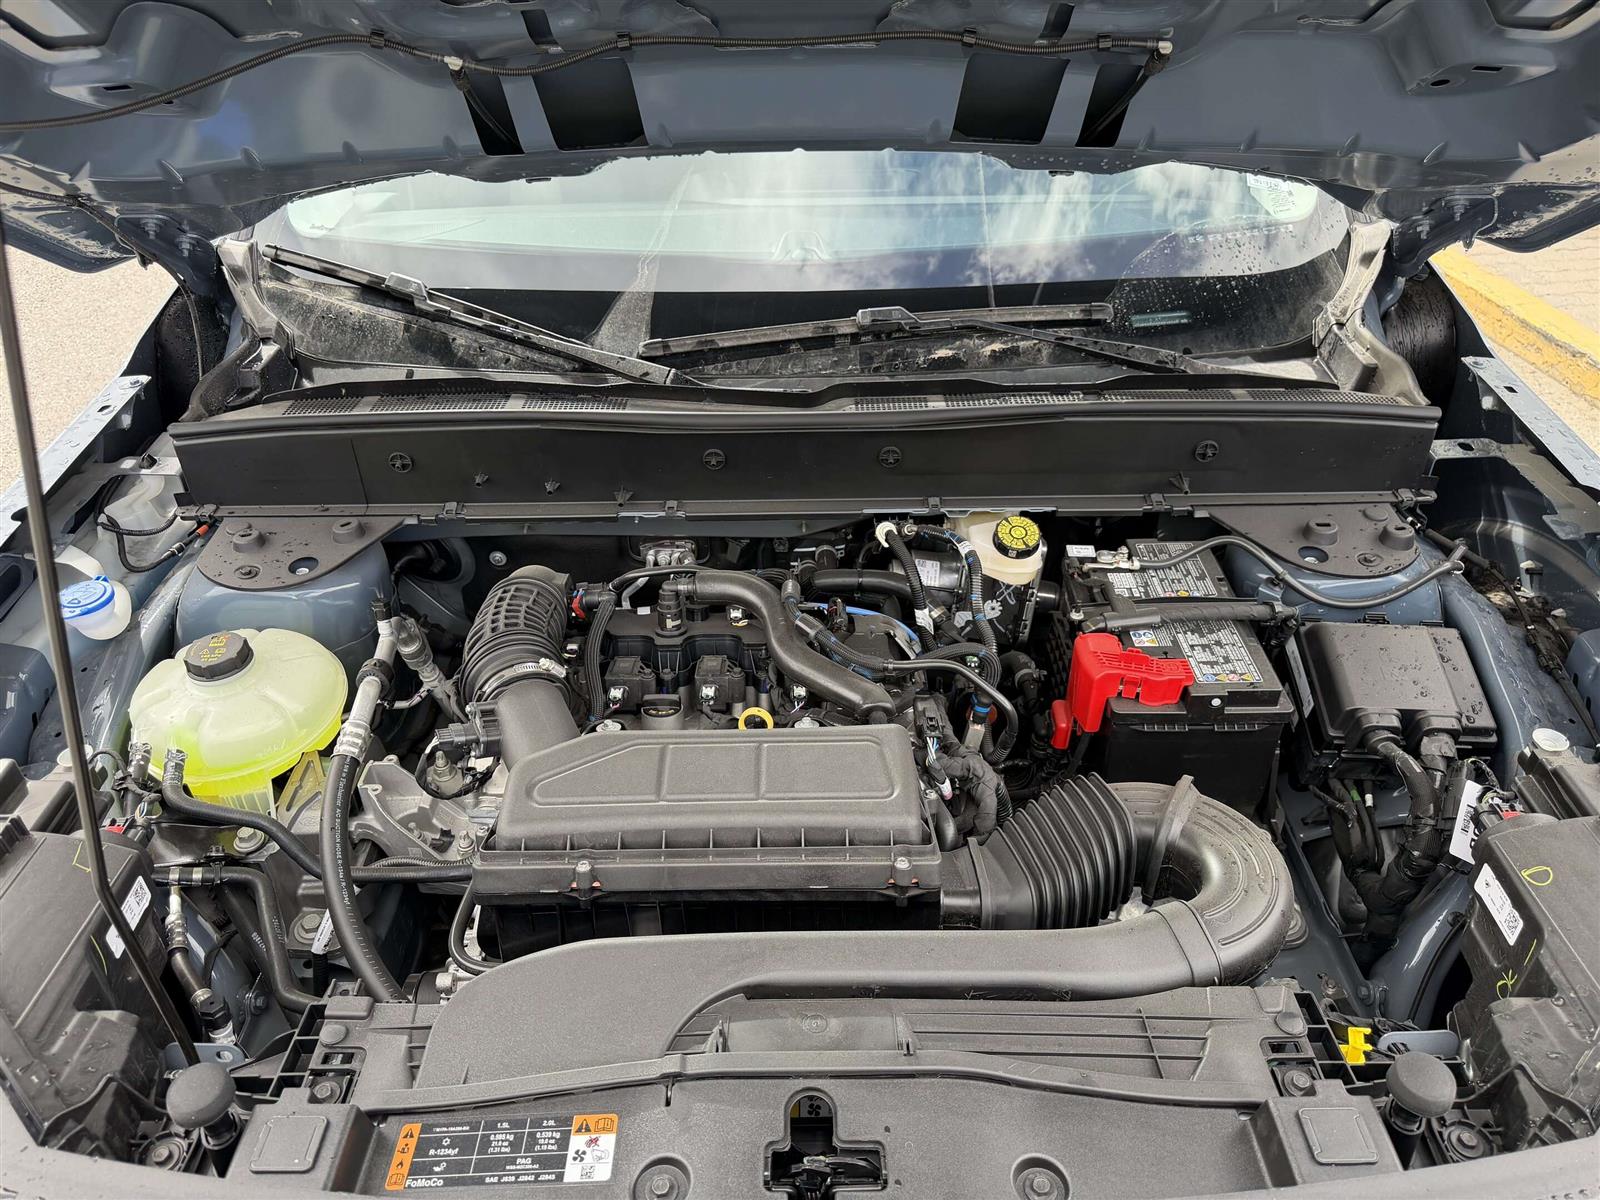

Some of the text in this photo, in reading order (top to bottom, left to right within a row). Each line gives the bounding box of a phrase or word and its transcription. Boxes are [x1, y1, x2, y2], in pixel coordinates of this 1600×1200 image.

[428, 1147, 460, 1156] R-1234yf
[516, 1157, 532, 1165] PAG
[405, 1178, 444, 1188] FoMoCo
